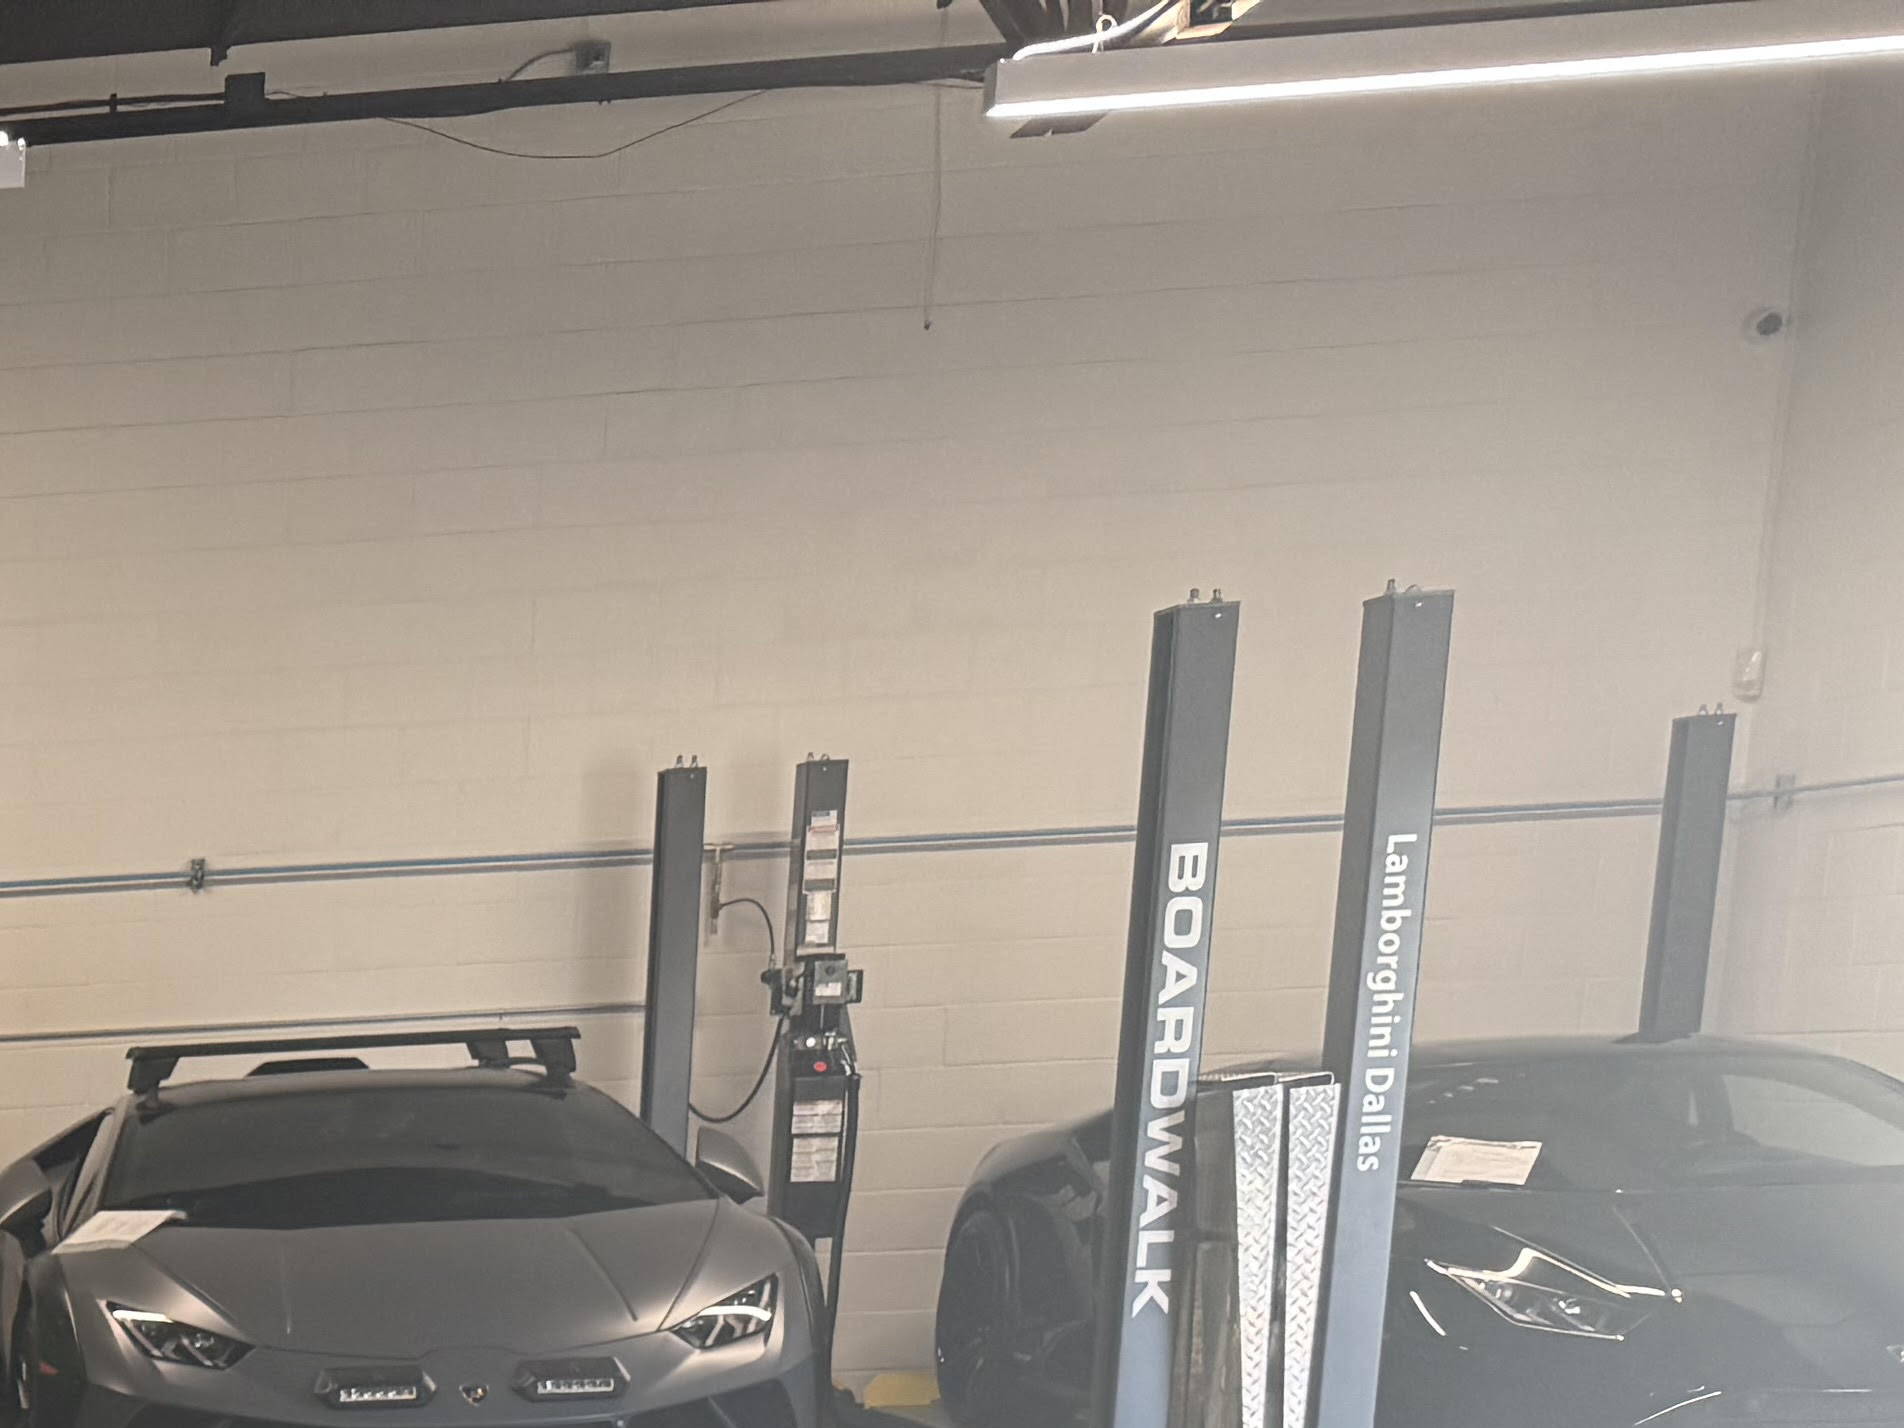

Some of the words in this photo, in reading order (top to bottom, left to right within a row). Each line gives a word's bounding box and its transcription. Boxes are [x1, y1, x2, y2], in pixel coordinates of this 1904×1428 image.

[1366, 833, 1418, 1057] Lamborghini
[1131, 842, 1209, 1318] BOARDWALK
[1356, 1067, 1395, 1172] Dallas
